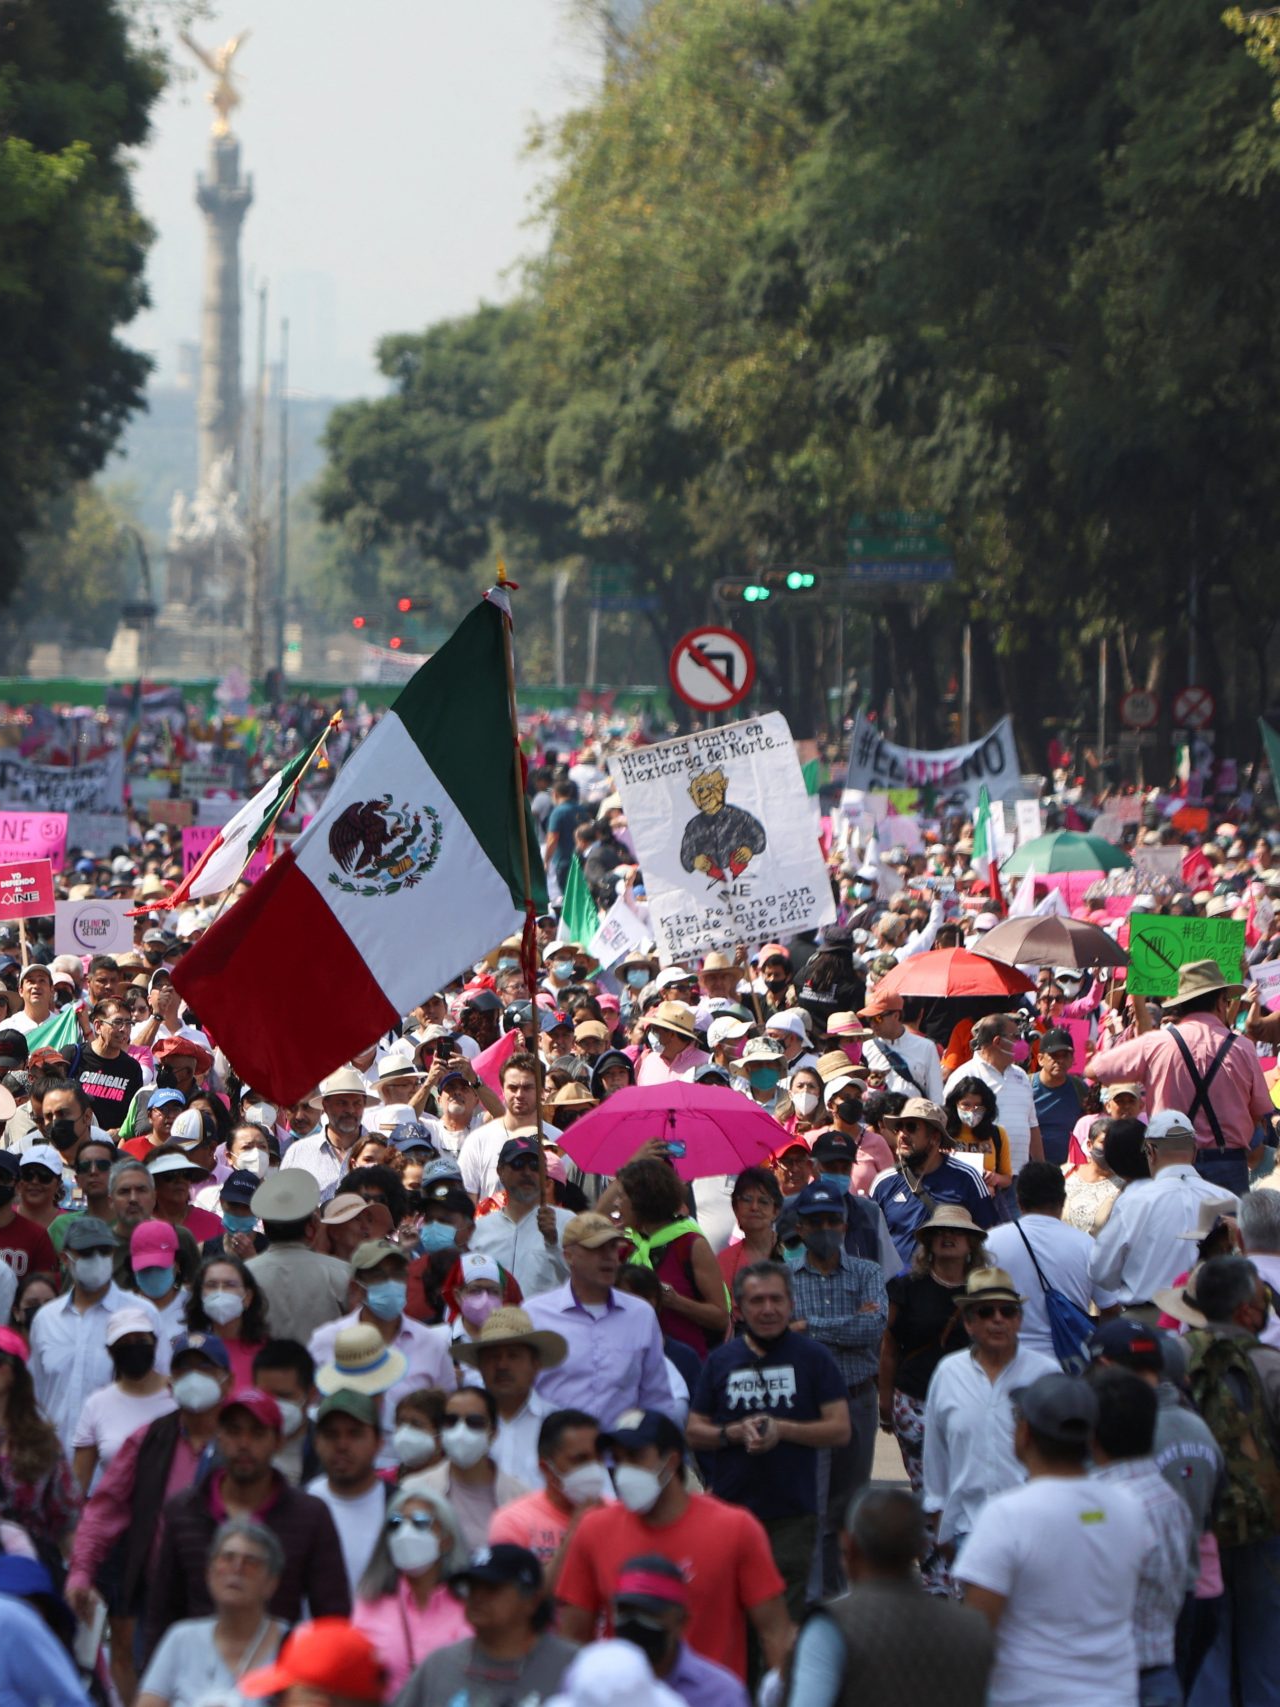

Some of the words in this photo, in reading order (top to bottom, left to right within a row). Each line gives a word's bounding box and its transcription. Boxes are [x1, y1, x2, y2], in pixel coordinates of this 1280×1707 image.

[619, 741, 690, 772] Mientras
[694, 728, 743, 751] tanto,
[745, 723, 764, 737] en
[623, 754, 704, 786] Mexicorea
[707, 748, 728, 763] del
[0, 877, 36, 888] DEFIENDO
[11, 872, 22, 881] YO
[13, 890, 40, 904] INE
[664, 918, 722, 941] decide
[733, 907, 768, 926] que
[744, 907, 813, 933] decidir
